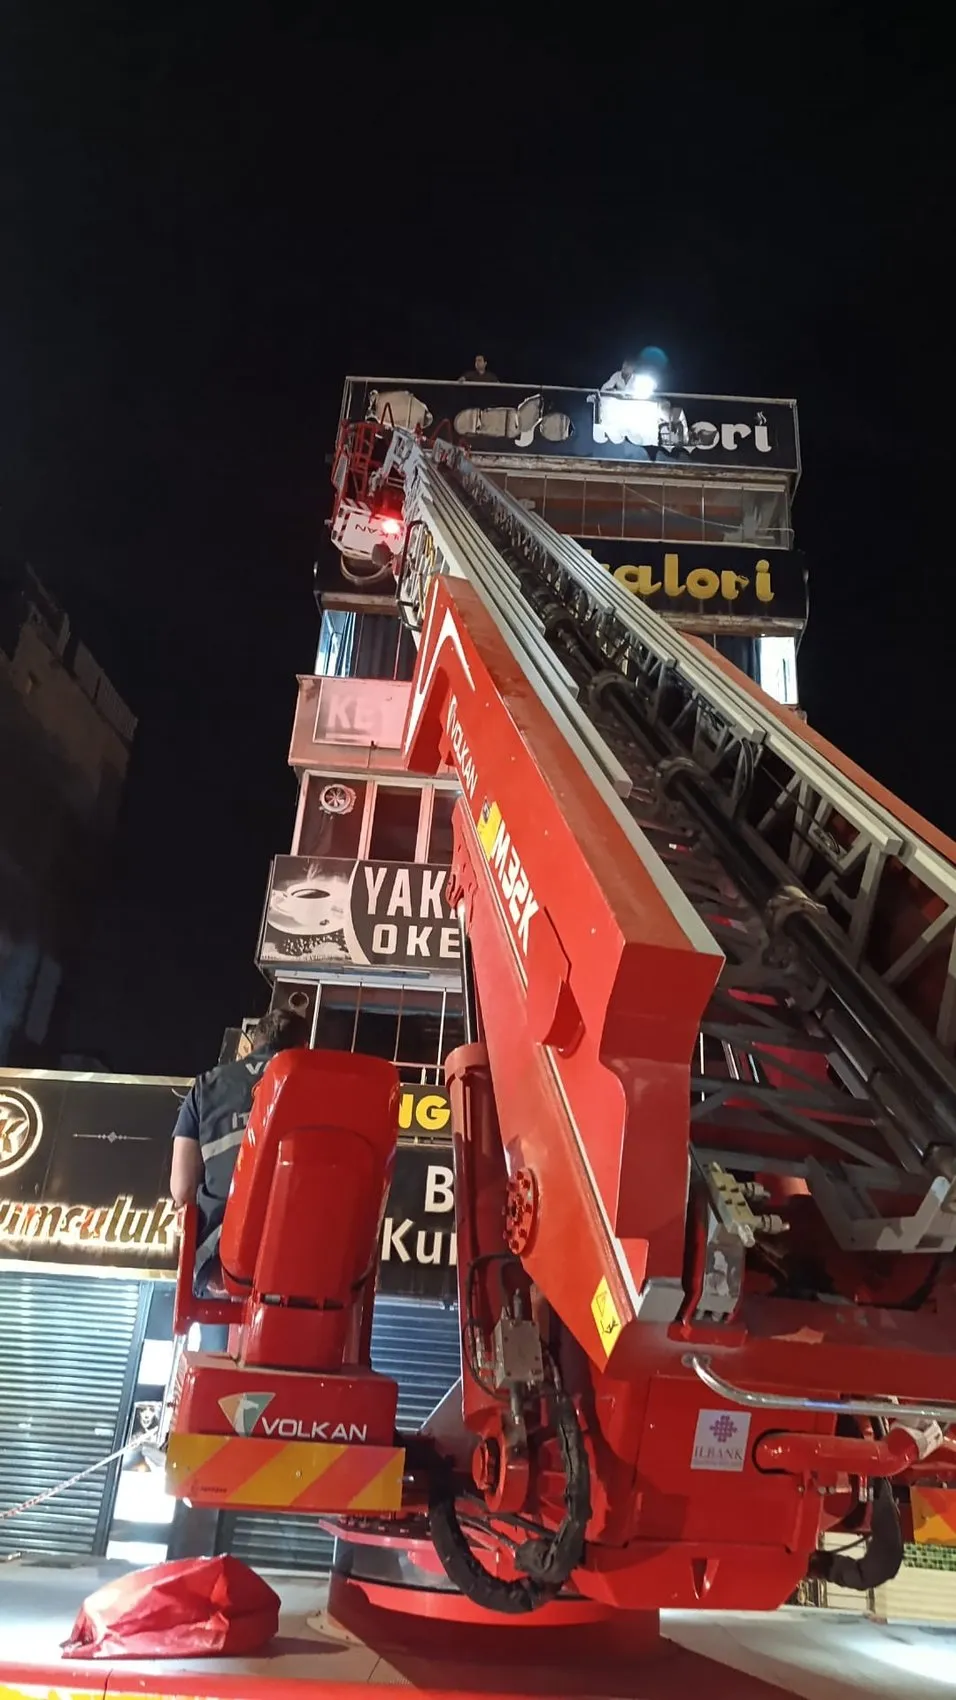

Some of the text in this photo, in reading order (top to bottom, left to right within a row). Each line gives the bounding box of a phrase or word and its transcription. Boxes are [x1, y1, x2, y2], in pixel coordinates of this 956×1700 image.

[588, 549, 775, 602] alori
[364, 866, 458, 919] YAK
[262, 1416, 367, 1442] VOLKAN
